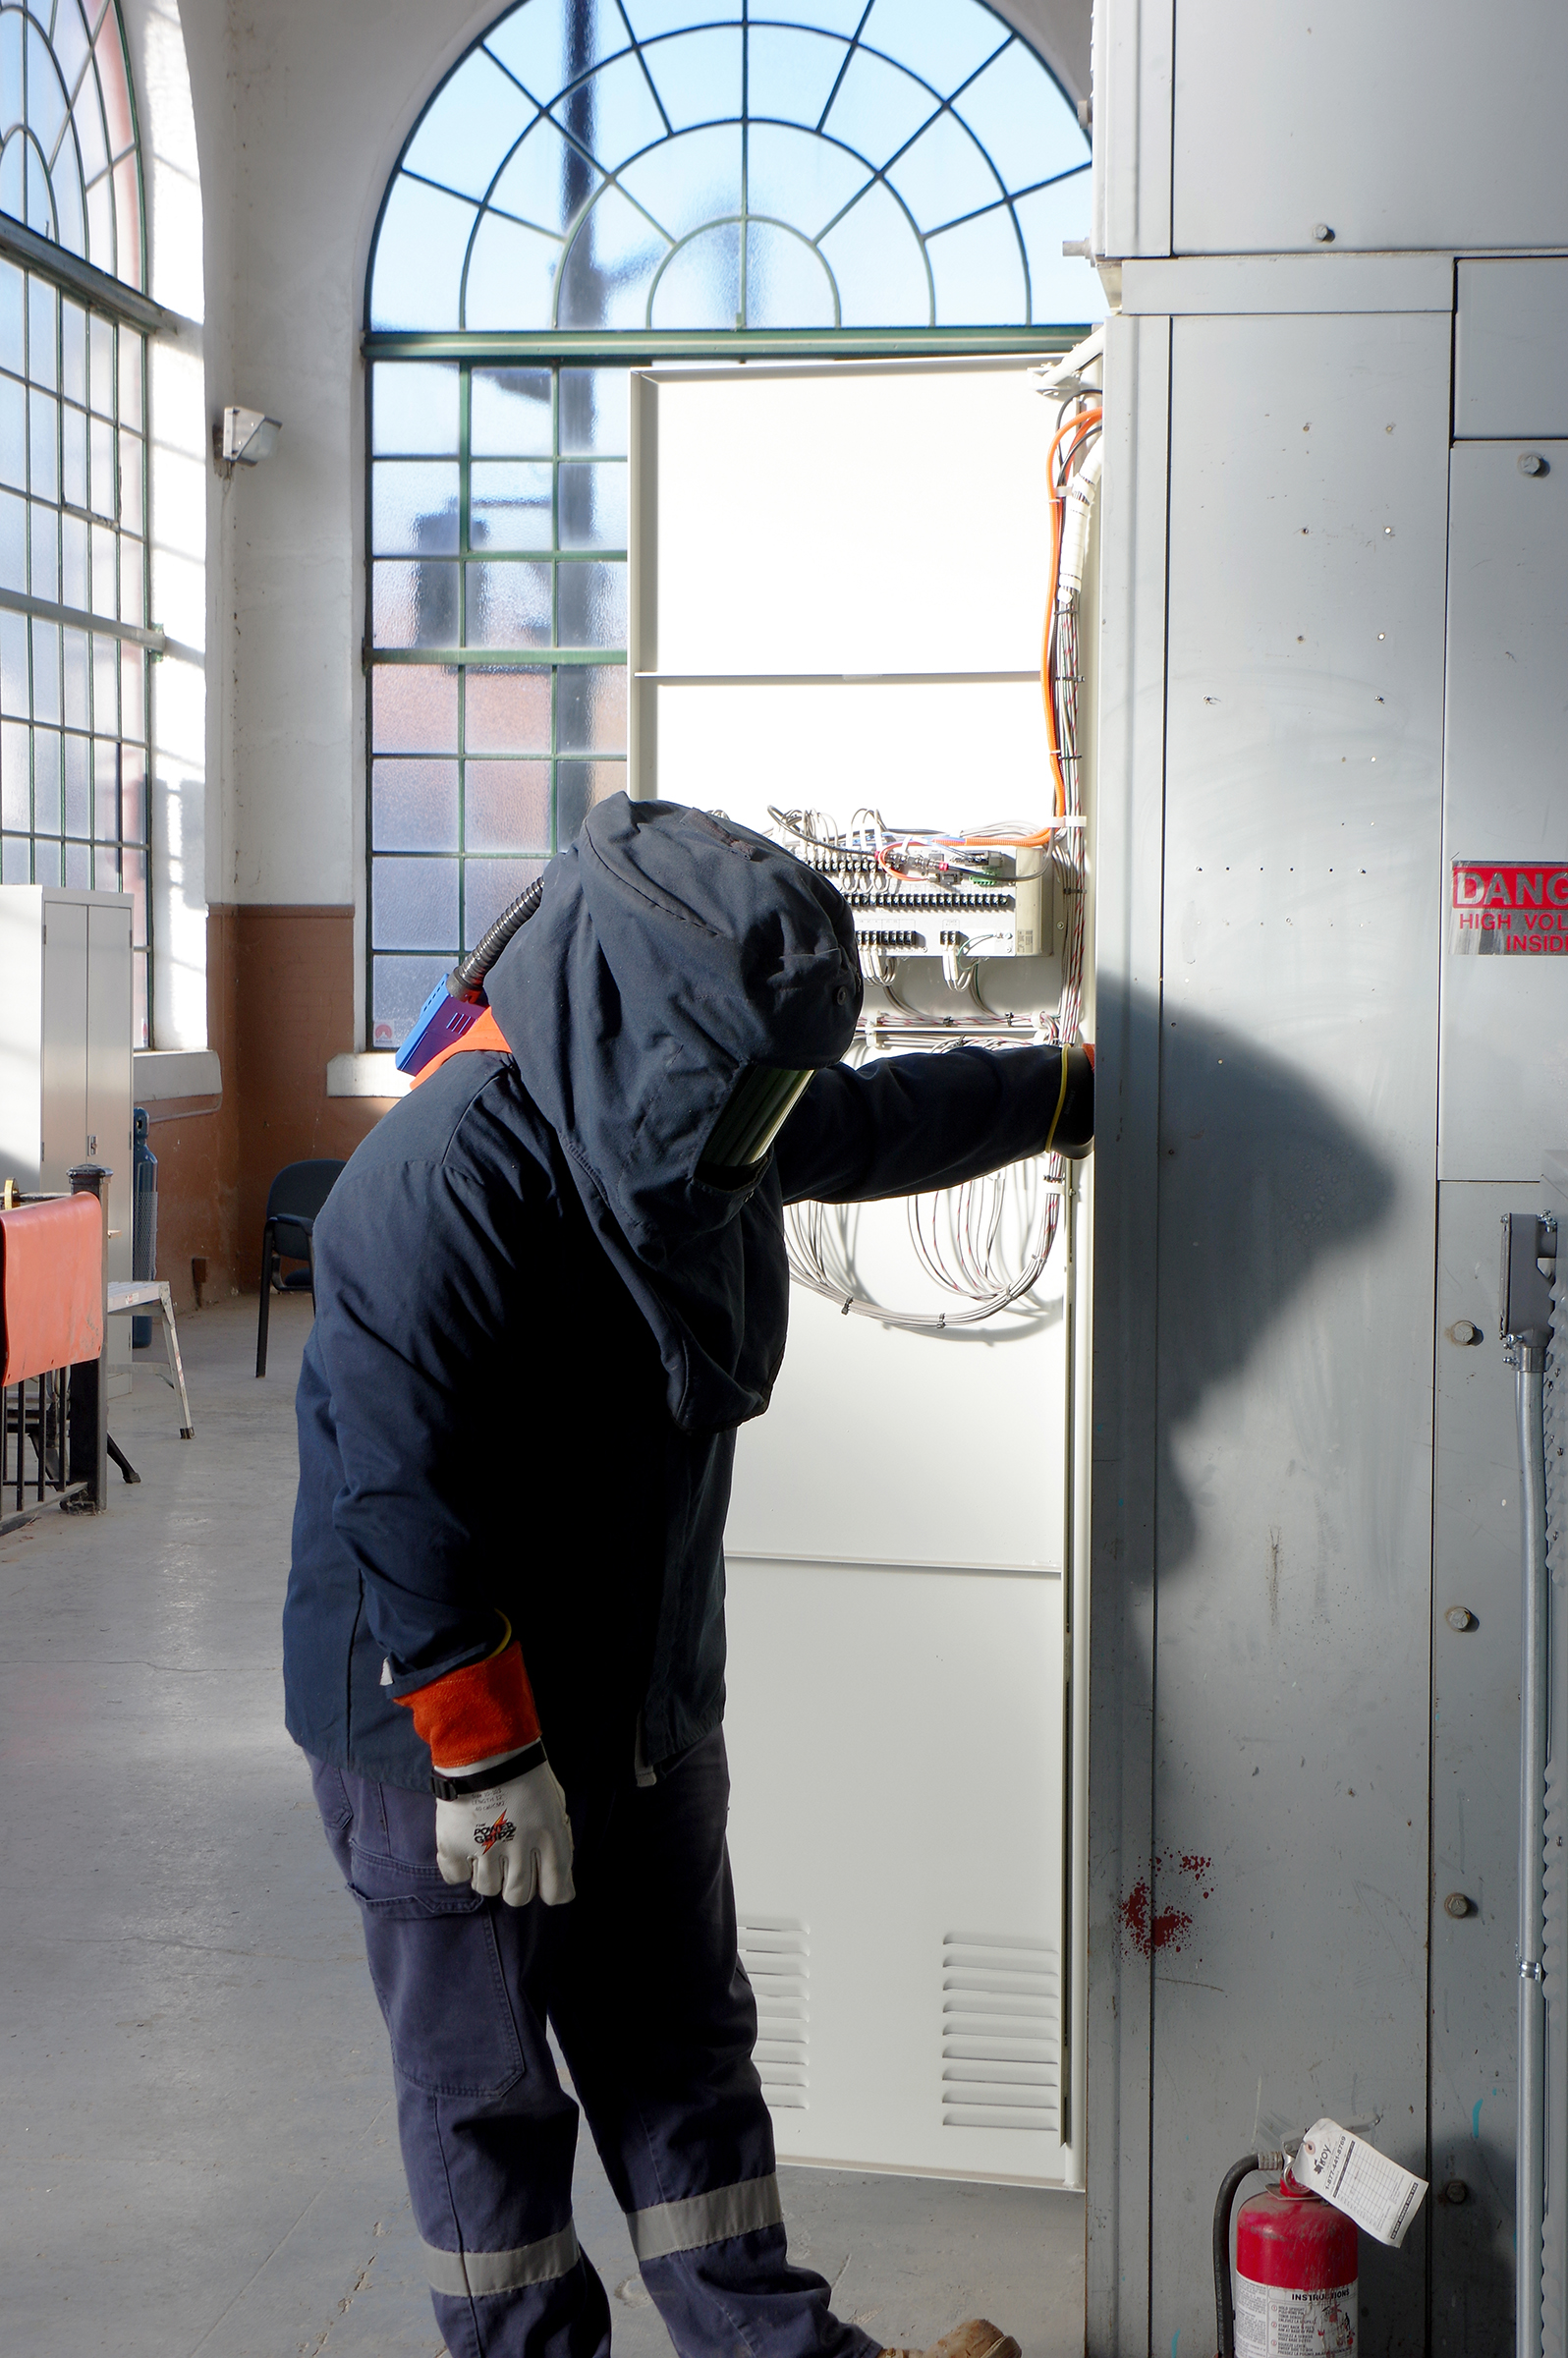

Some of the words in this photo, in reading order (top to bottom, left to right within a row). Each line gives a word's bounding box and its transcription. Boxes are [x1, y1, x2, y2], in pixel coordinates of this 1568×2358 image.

[1460, 913, 1511, 929] HIGH
[1525, 913, 1568, 930] VOL
[1506, 934, 1568, 952] INSID
[474, 1822, 514, 1836] POWER
[475, 1826, 517, 1844] GRIPZ
